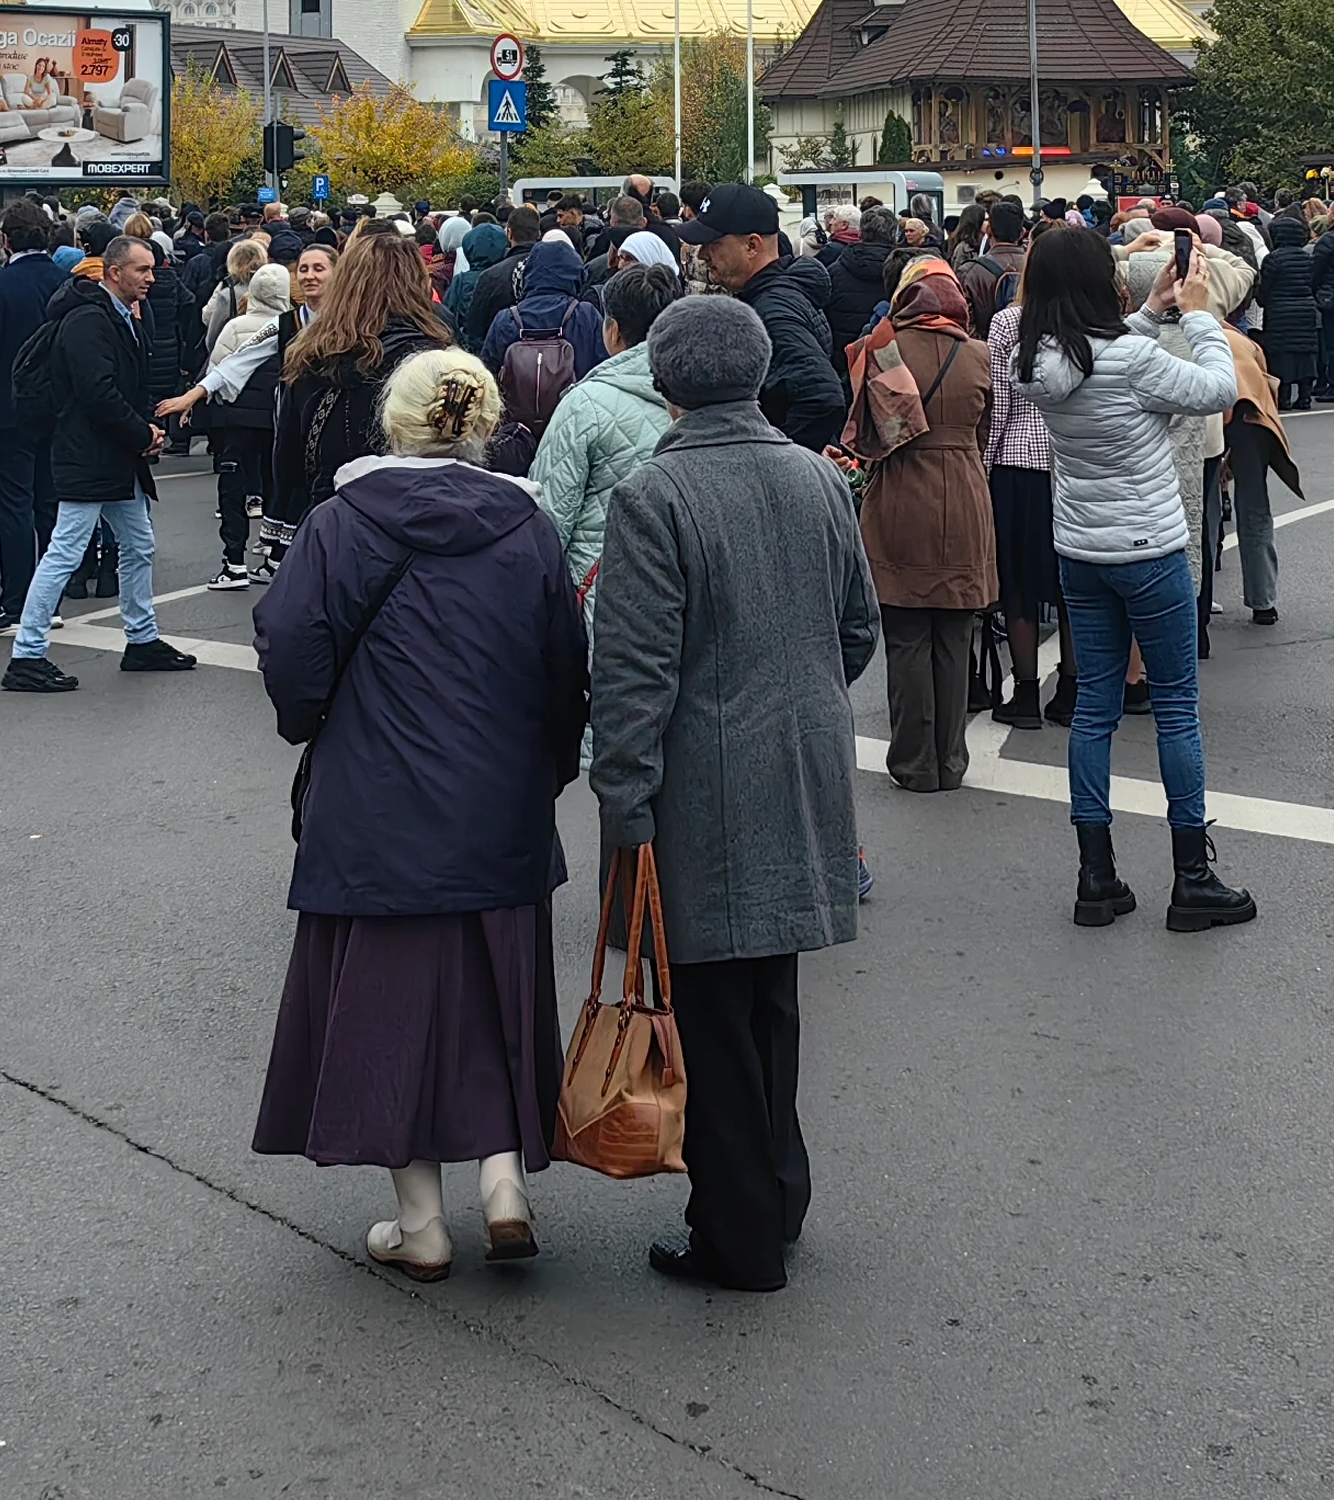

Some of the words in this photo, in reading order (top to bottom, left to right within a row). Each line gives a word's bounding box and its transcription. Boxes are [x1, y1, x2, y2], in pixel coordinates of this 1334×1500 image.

[23, 28, 76, 47] Ocazii
[87, 163, 151, 174] MOBEXPERT
[315, 177, 325, 192] P
